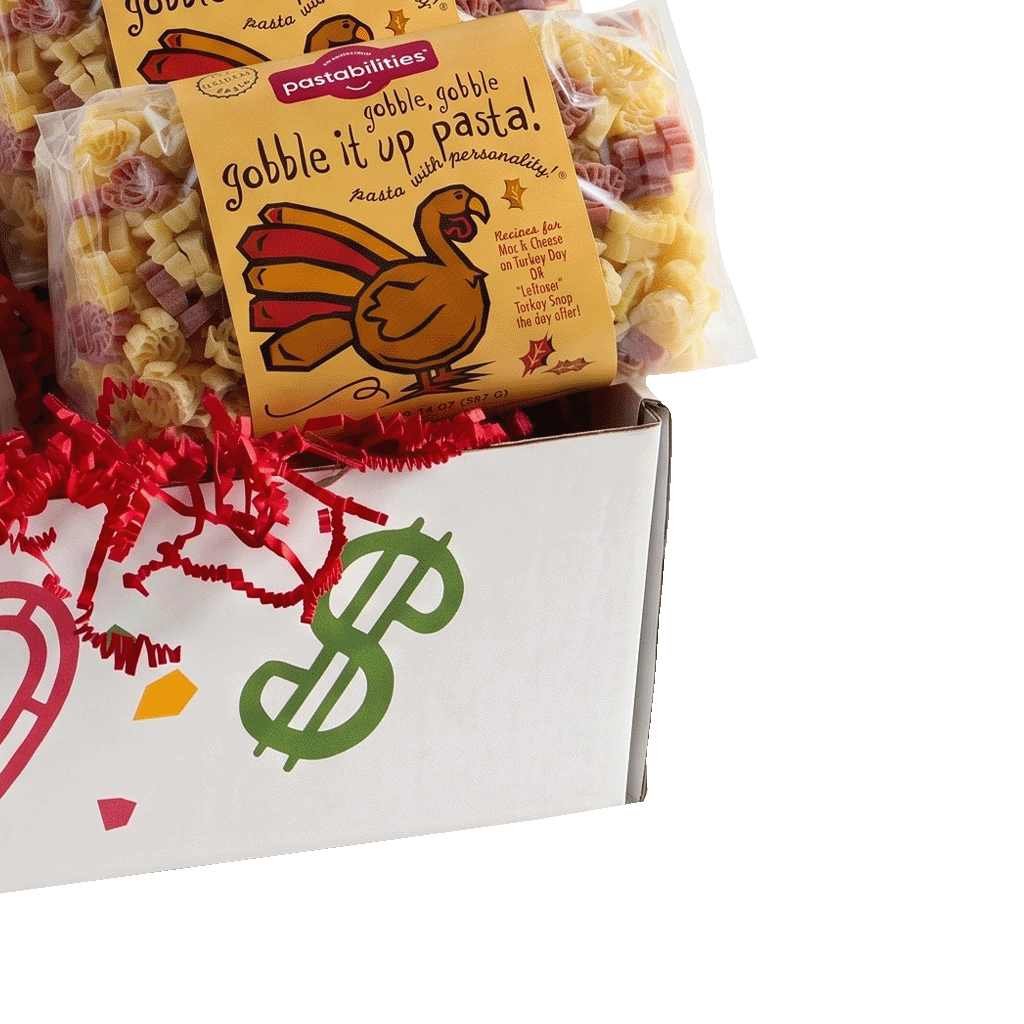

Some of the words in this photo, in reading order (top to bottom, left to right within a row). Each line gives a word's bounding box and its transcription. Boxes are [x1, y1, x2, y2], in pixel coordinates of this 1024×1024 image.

[243, 15, 297, 31] pasta
[363, 87, 433, 133] gobble,
[436, 70, 499, 113] gobble
[221, 132, 331, 212] gobble
[334, 124, 368, 169] it
[378, 130, 415, 175] up
[432, 76, 541, 162] pasta!
[349, 185, 406, 202] pasta
[410, 156, 443, 187] with
[448, 148, 559, 178] personality!
[530, 235, 564, 250] Cheese
[500, 261, 513, 271] on
[516, 316, 532, 328] the
